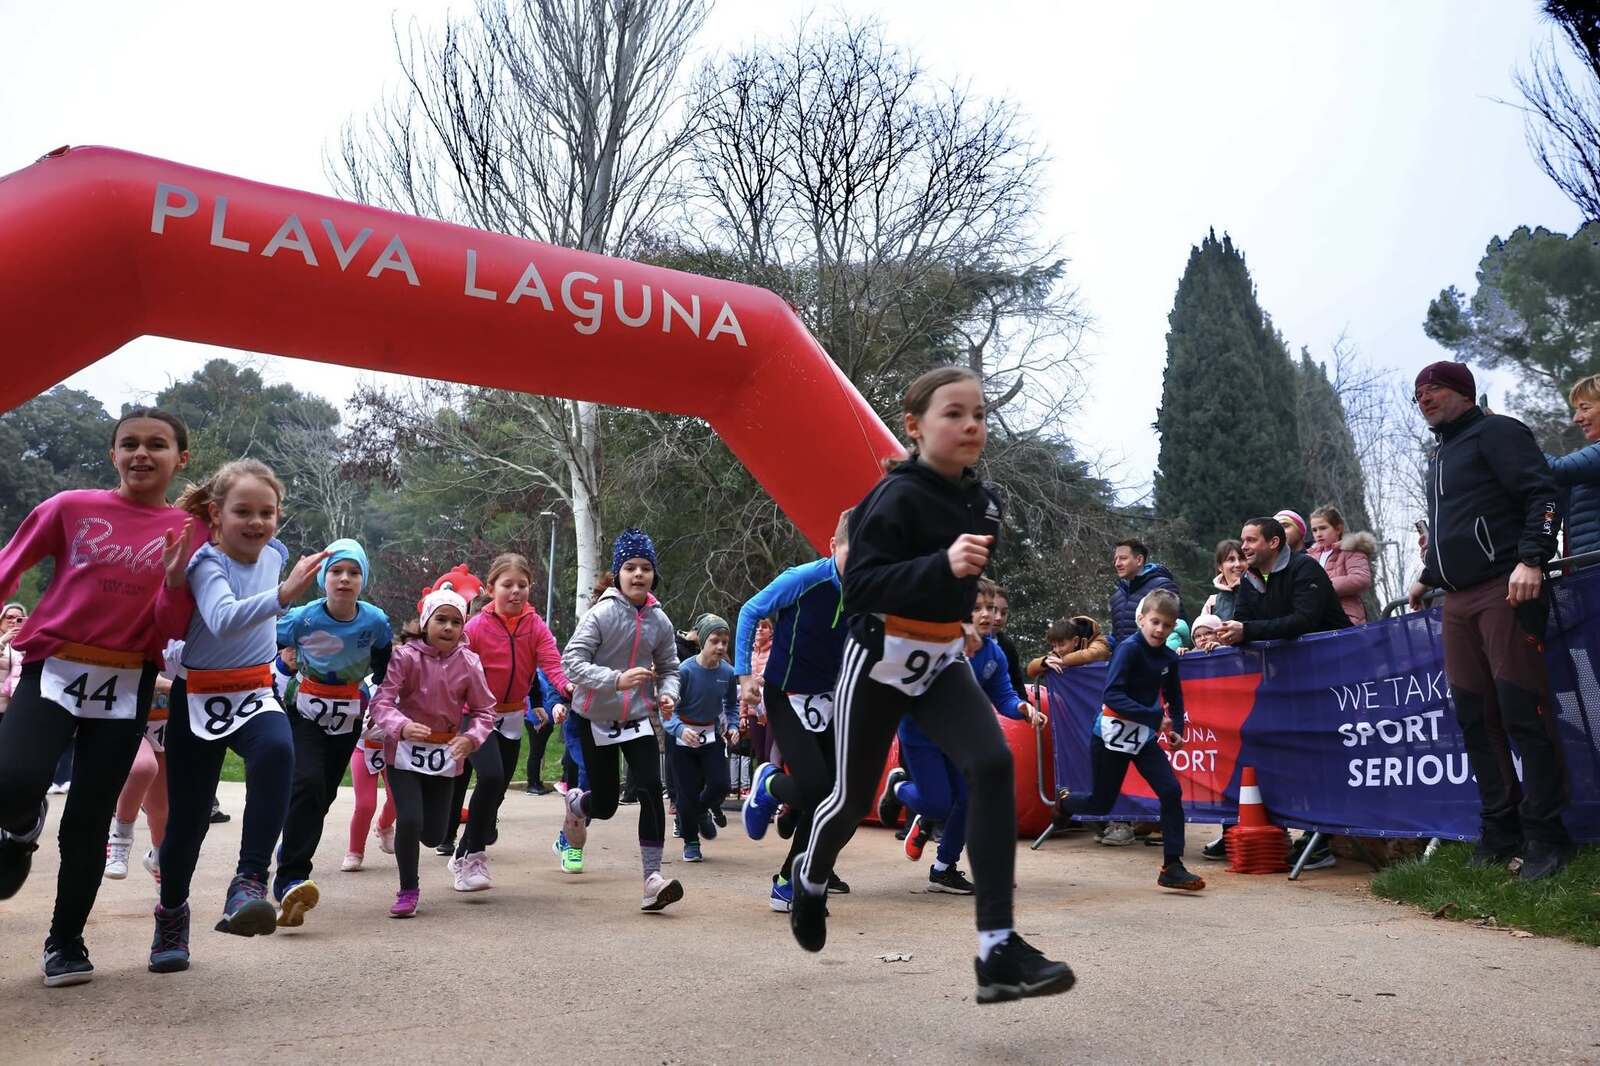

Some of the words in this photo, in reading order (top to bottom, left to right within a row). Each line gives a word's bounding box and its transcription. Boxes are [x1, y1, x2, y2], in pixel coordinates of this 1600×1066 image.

[150, 181, 421, 287] PLAVA
[464, 248, 748, 347] LAGUNA
[63, 672, 118, 711] 44
[1329, 681, 1380, 711] WE
[1383, 670, 1452, 706] TAK
[204, 692, 264, 735] 86
[308, 698, 351, 732] 25
[1338, 709, 1444, 747] SPORT
[1109, 719, 1142, 752] 24
[410, 745, 446, 772] 50
[1347, 752, 1478, 788] SERIOU
